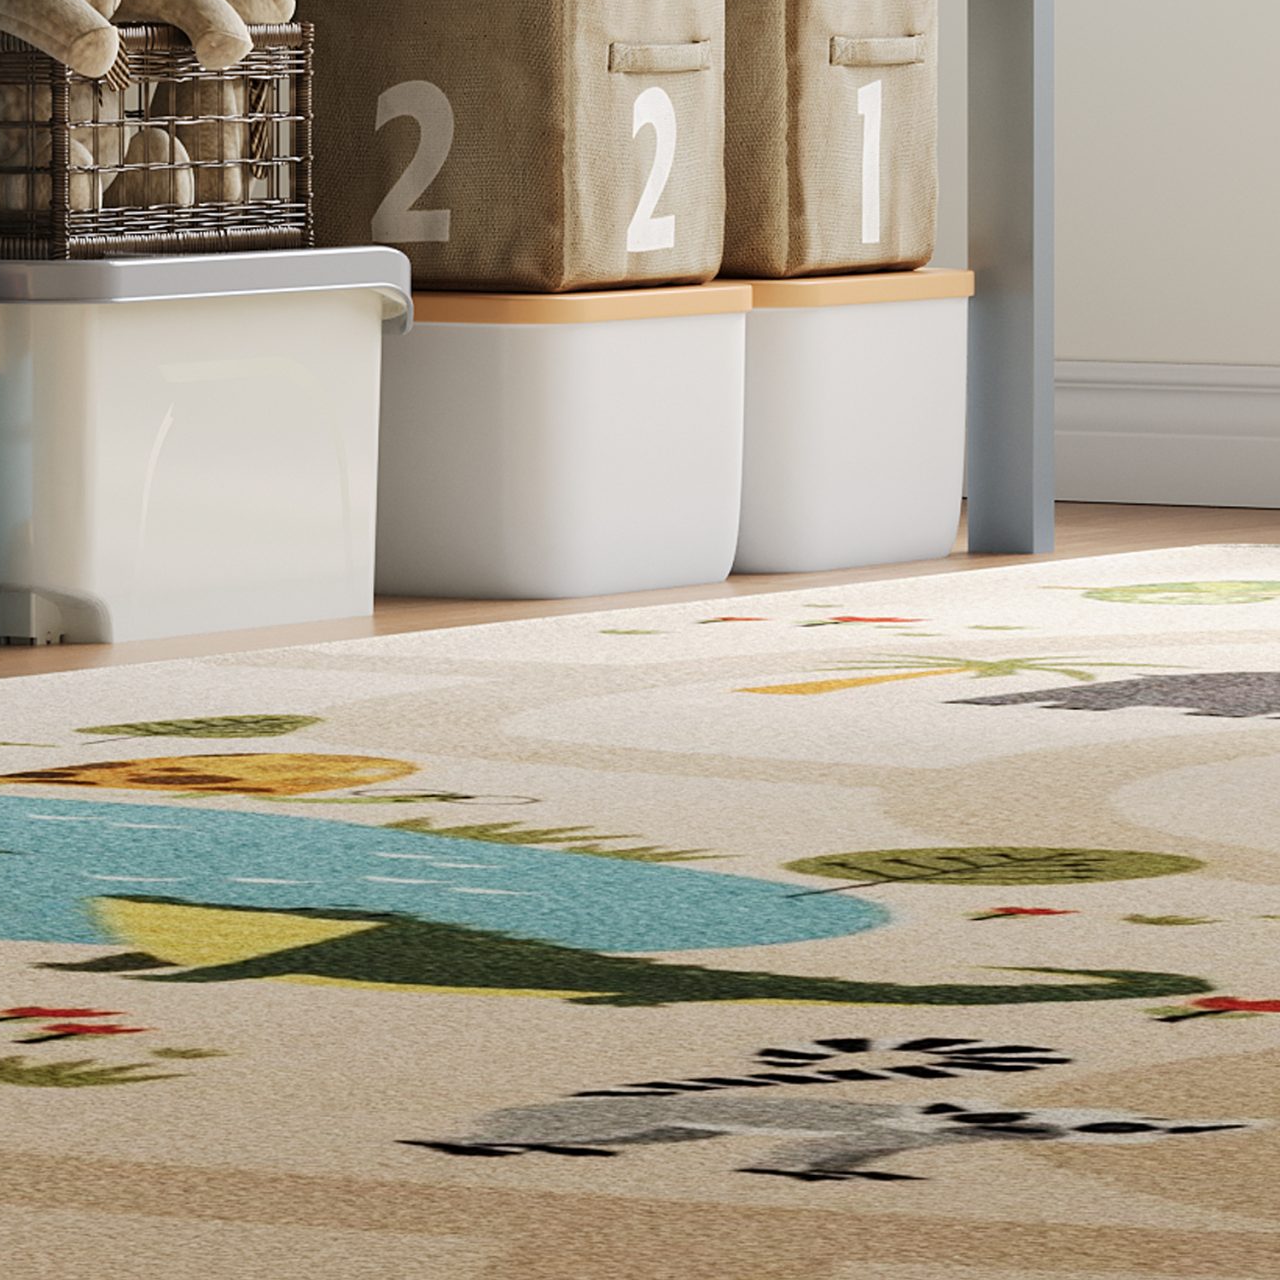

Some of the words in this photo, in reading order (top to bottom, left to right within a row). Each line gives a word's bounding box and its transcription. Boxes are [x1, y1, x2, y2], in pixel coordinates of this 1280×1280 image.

[371, 80, 455, 244] 2
[627, 86, 677, 252] 2
[857, 79, 883, 244] 1
